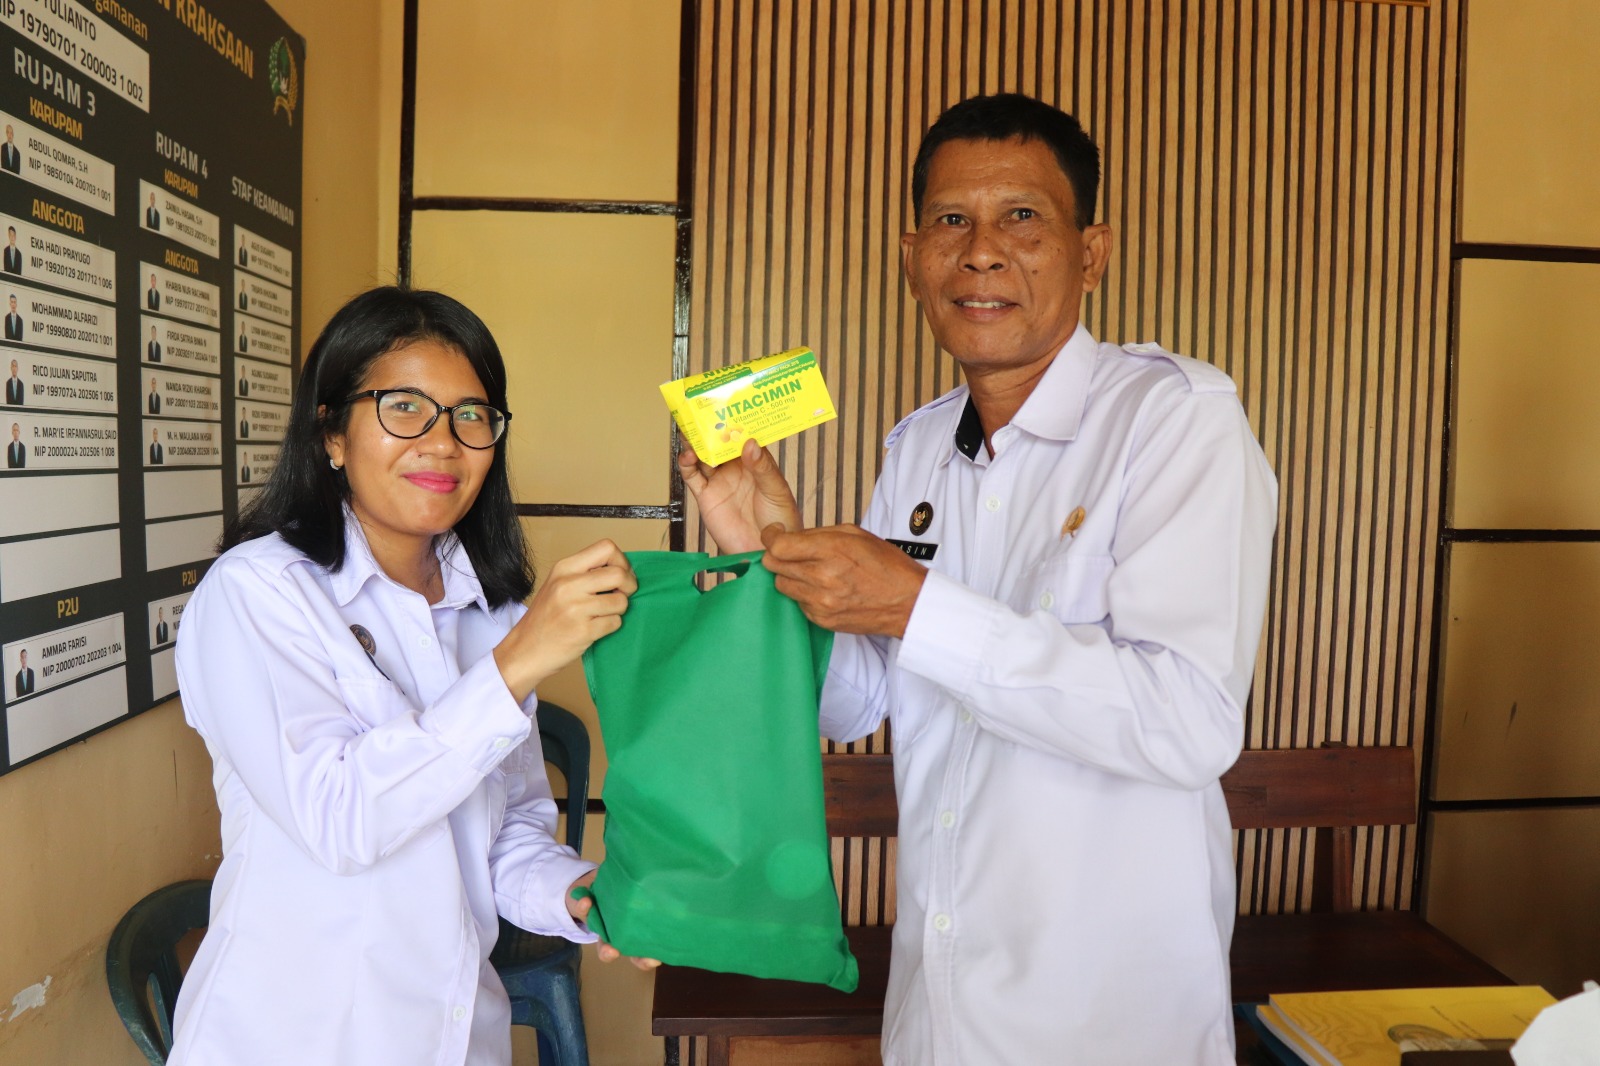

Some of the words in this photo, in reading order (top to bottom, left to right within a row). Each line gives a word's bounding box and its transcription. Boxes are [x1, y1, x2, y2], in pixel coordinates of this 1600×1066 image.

[176, 0, 254, 79] KRAKSAAN
[20, 8, 77, 61] 19790701
[80, 48, 117, 87] 200003
[119, 74, 125, 92] 1
[127, 79, 144, 103] 002
[14, 46, 81, 110] RUPAM
[87, 91, 96, 117] 3
[29, 96, 83, 140] KARUPAM
[28, 137, 52, 158] ABDUL
[52, 148, 78, 172] QOMAR,
[78, 160, 89, 174] S.H
[156, 131, 199, 174] RUPAM
[201, 159, 208, 179] 4
[29, 157, 42, 171] NIP
[43, 164, 74, 186] 19850104
[75, 177, 96, 196] 200703
[101, 189, 112, 203] 001
[164, 168, 199, 199] KARUPAM
[32, 198, 85, 234] ANGGOTA
[231, 175, 252, 203] STAF
[253, 188, 295, 227] KEAMANAN
[30, 236, 44, 250] EKA
[45, 241, 62, 257] HADI
[62, 247, 91, 266] PRAYUGO
[165, 248, 199, 275] ANGGOTA
[31, 256, 44, 269] NIP
[45, 260, 76, 279] 19920129
[76, 269, 98, 285] 201712
[31, 301, 73, 321] MOHAMMAD
[32, 321, 45, 333] NIP
[46, 324, 77, 340] 19990820
[77, 330, 98, 344] 202012
[32, 364, 49, 377] RICO
[50, 366, 71, 380] JULIAN
[71, 369, 98, 383] SAPUTRA
[33, 384, 45, 396] NIP
[46, 386, 77, 398] 19970724
[78, 388, 99, 400] 202506
[714, 378, 802, 422] VITACIMIN
[733, 410, 760, 424] Vitamin
[760, 406, 766, 414] C
[770, 400, 784, 410] 500
[784, 396, 796, 404] mg
[33, 426, 41, 438] R.
[105, 430, 117, 440] SAID
[34, 446, 46, 457] NIP
[47, 446, 78, 457] 20000224
[79, 446, 100, 457] 202506
[182, 569, 197, 586] P2U
[57, 596, 79, 618] P2U
[42, 639, 67, 660] AMMAR
[67, 636, 87, 653] FARISI
[42, 664, 55, 678] NIP
[55, 654, 86, 674] 20000702
[86, 646, 108, 663] 202203
